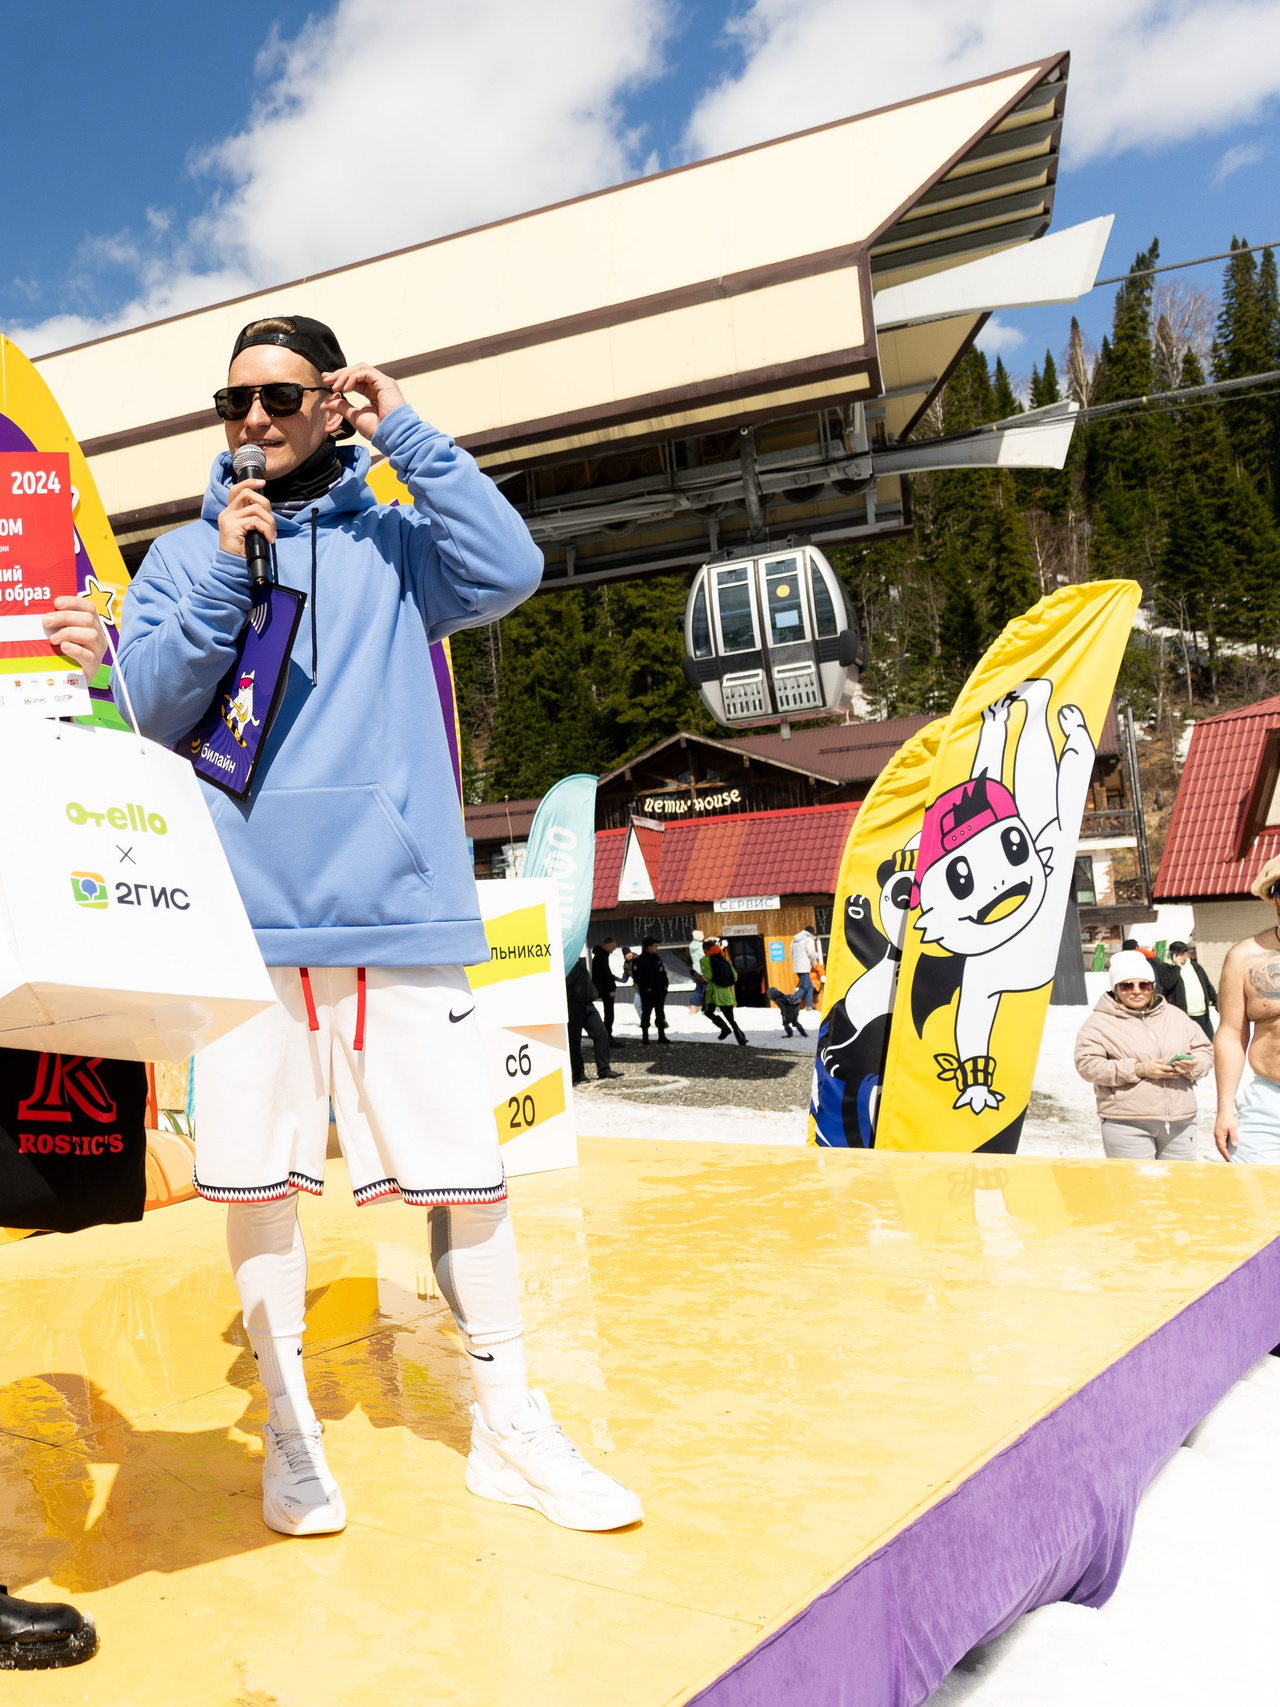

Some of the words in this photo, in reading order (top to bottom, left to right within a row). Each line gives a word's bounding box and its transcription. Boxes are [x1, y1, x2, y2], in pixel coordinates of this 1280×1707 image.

[10, 470, 62, 495] 2024
[5, 583, 51, 606] образ
[201, 742, 236, 774] билайн
[65, 801, 168, 835] Otello
[115, 882, 191, 910] 2ГИС
[720, 898, 774, 911] СЕРВИС
[491, 944, 552, 961] льниках
[505, 1044, 532, 1077] сб
[508, 1095, 536, 1129] 20
[19, 1133, 124, 1155] ROSTIC'S
